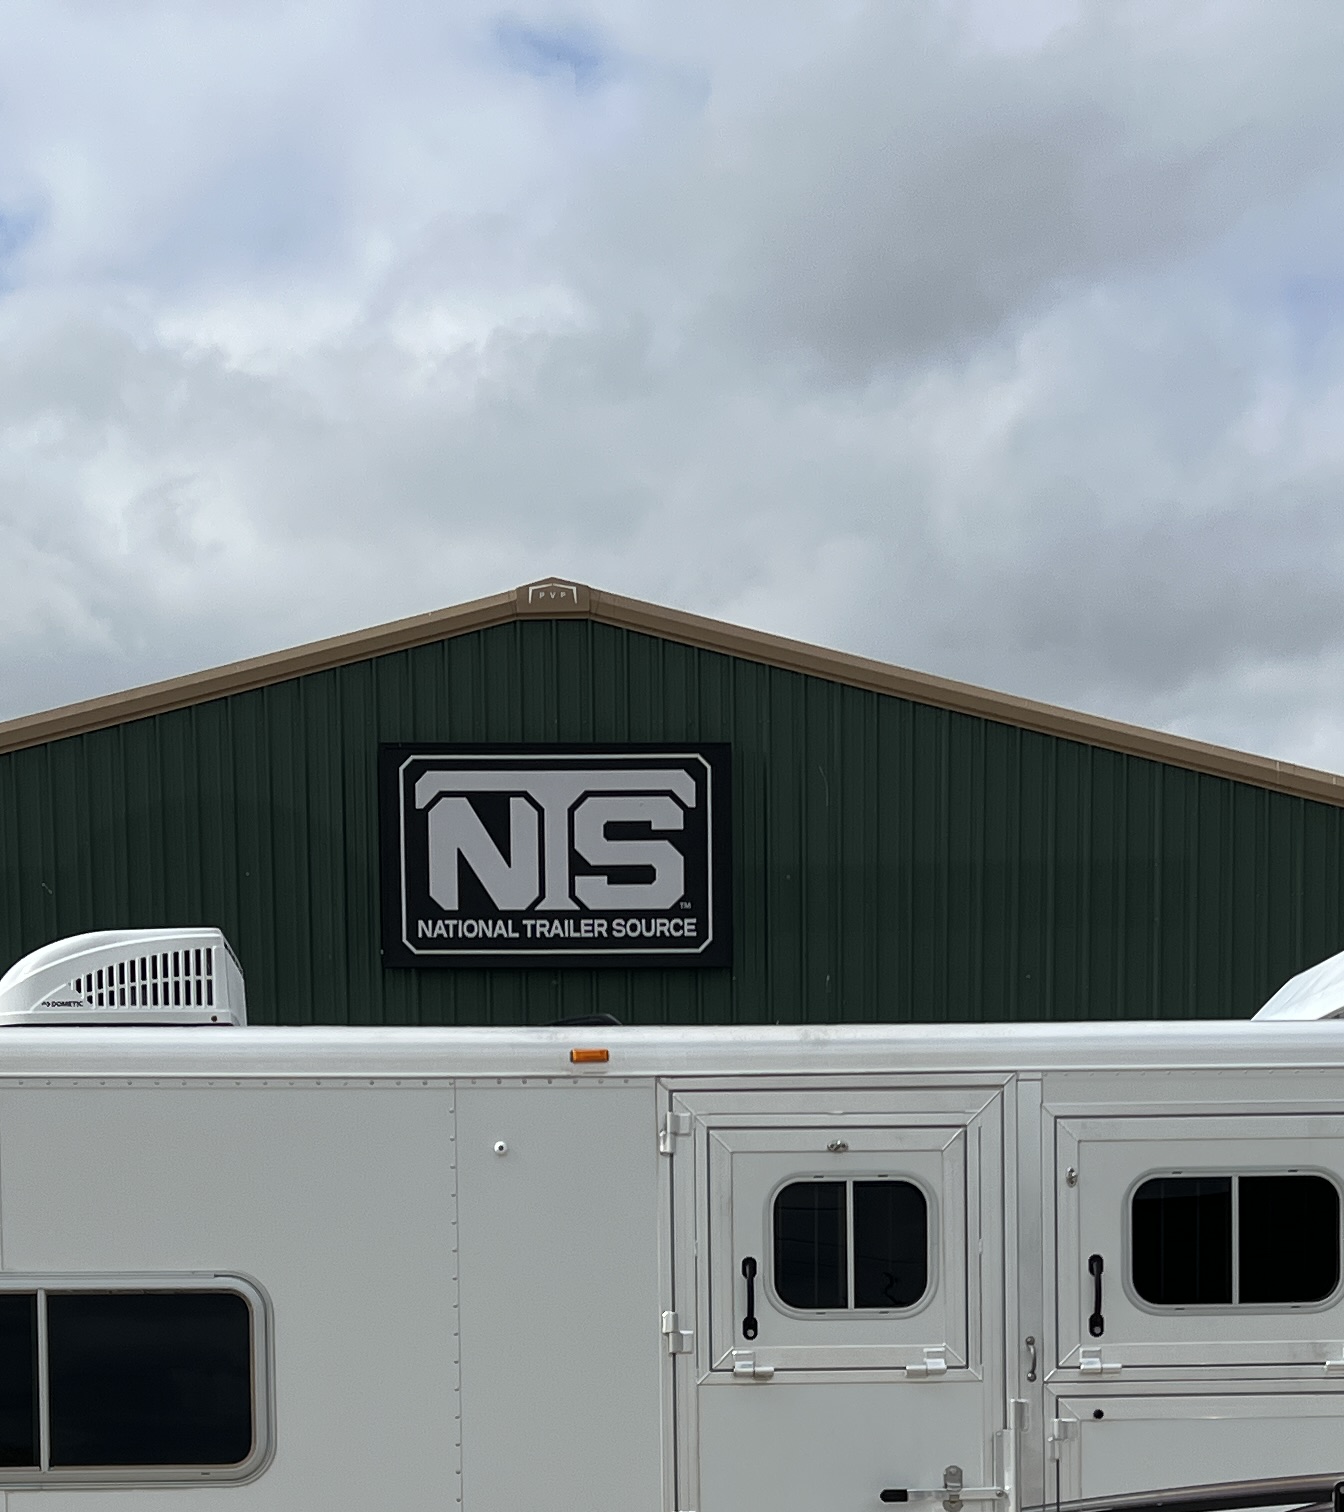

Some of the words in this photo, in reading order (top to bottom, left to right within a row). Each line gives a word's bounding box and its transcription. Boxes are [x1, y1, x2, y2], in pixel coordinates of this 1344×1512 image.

[415, 769, 696, 910] NTS
[417, 919, 520, 938] NATIONAL
[522, 918, 608, 938] TRAILER
[611, 917, 697, 938] SOURCE
